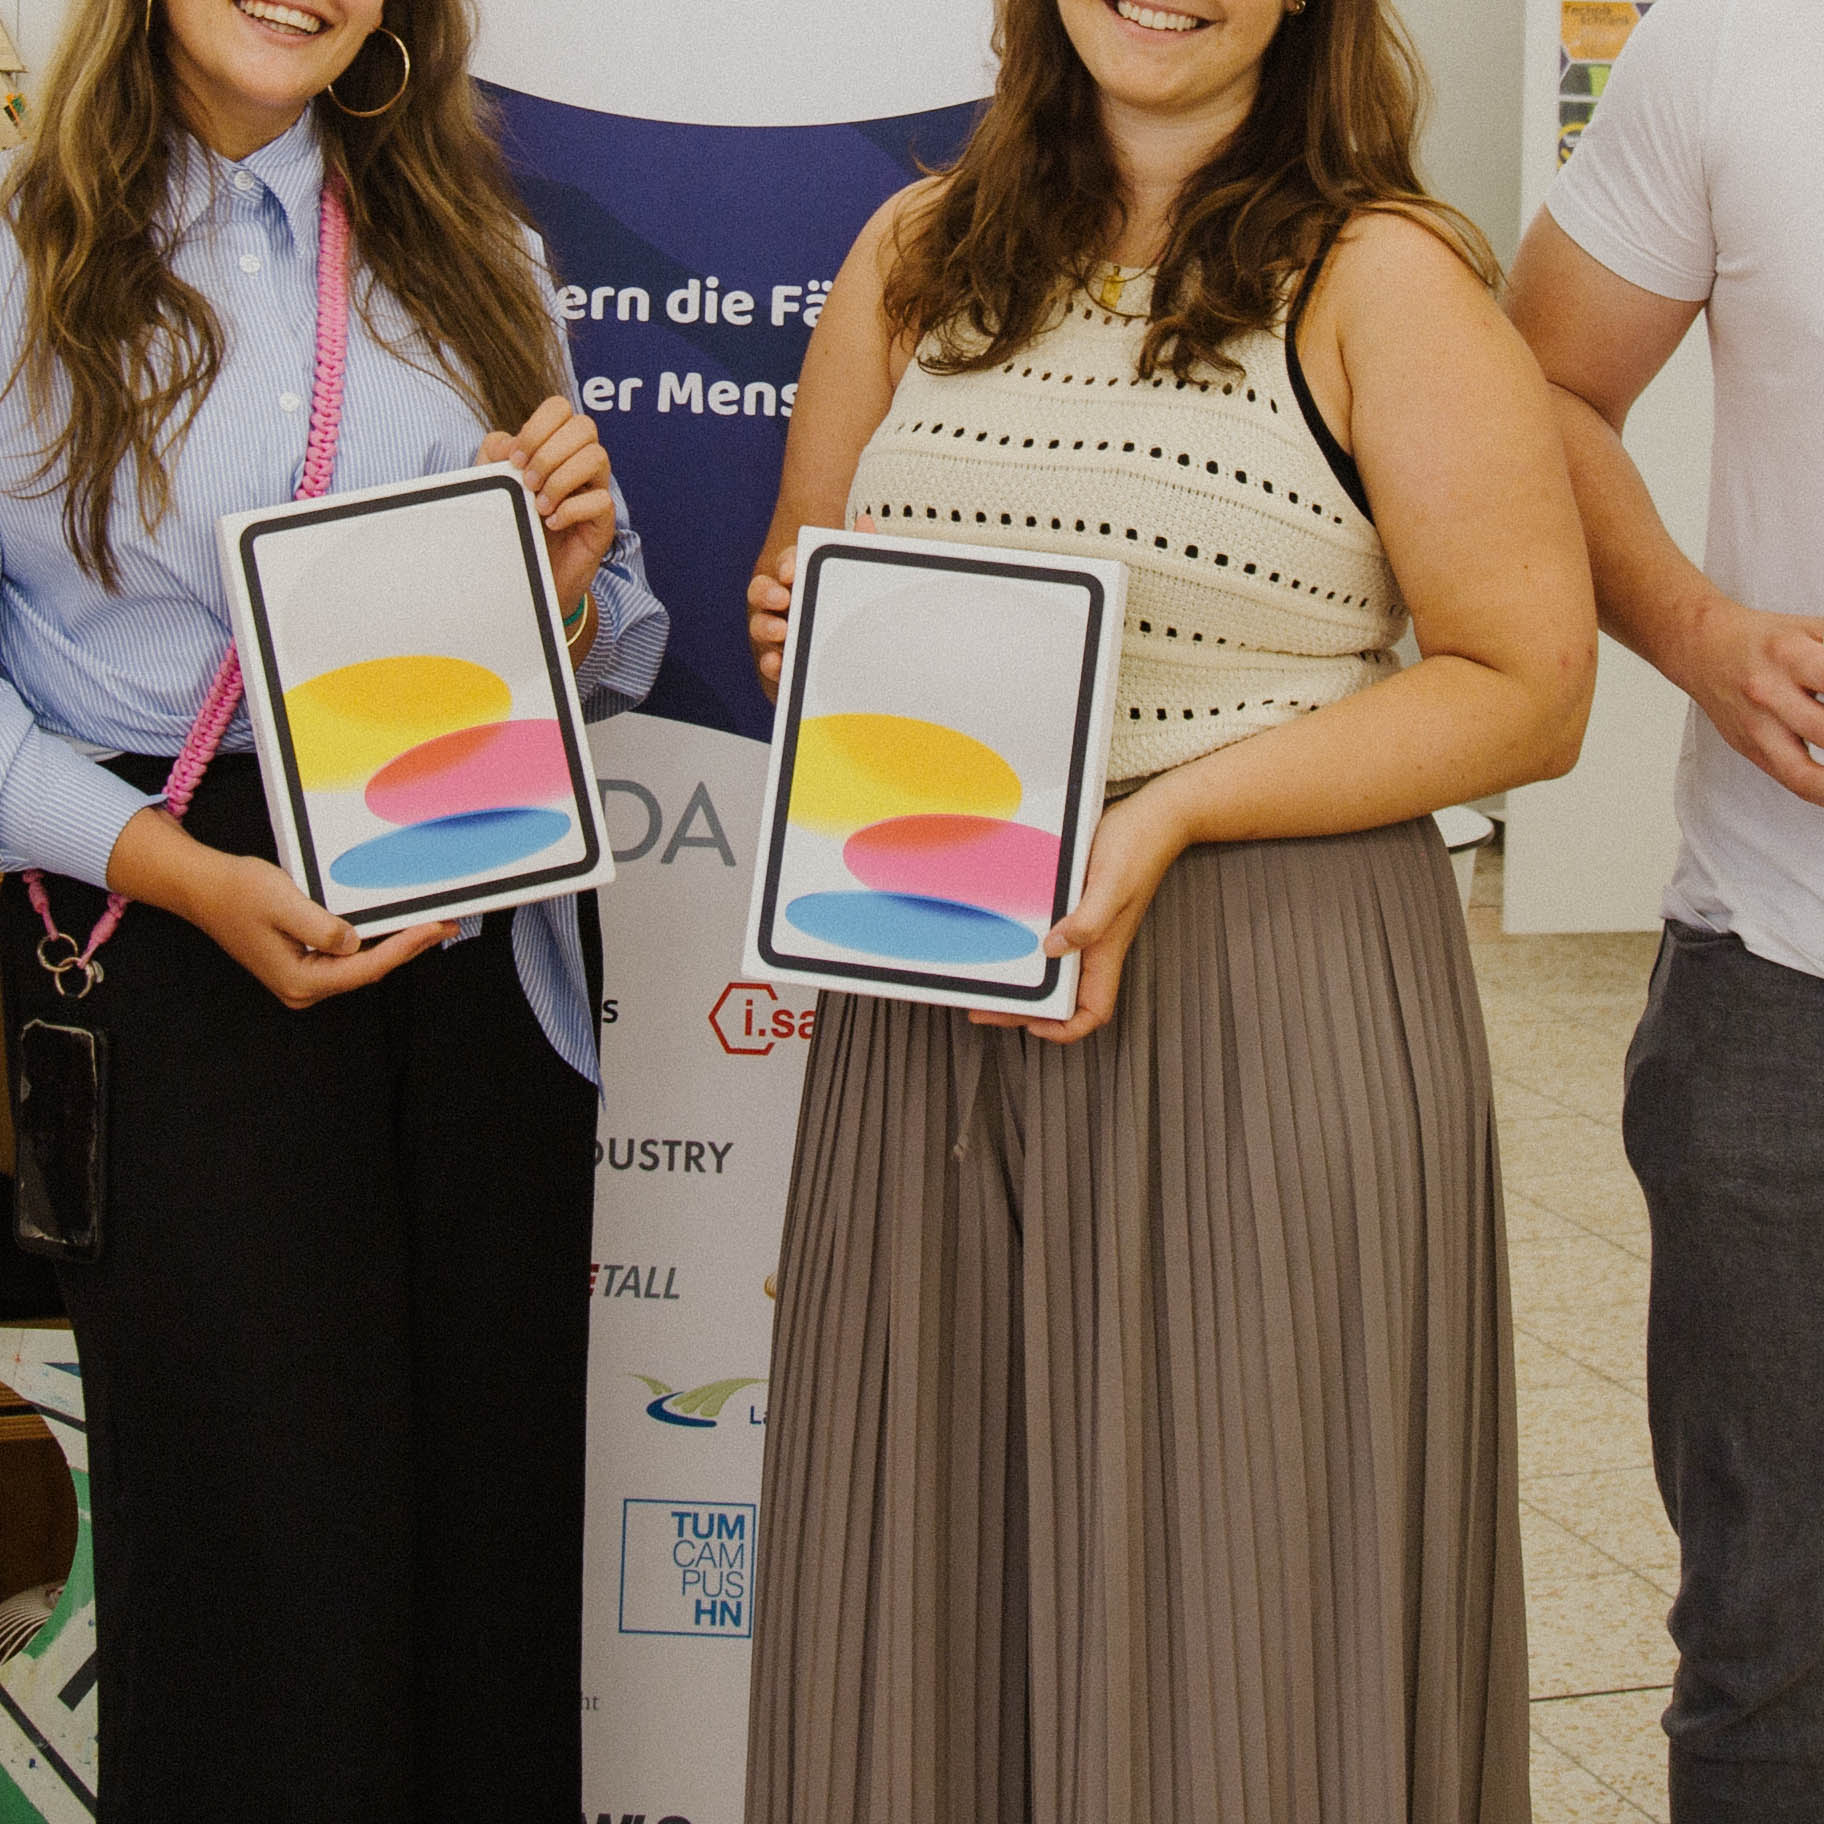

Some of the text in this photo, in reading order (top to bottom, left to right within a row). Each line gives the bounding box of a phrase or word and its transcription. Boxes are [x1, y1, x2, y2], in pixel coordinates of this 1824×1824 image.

[559, 275, 834, 328] ern die Fä
[582, 370, 799, 417] er Mens
[596, 778, 737, 867] DA
[743, 998, 816, 1041] i.sa
[671, 1511, 746, 1540] TUM
[673, 1539, 745, 1569] CAM
[682, 1569, 745, 1599] PUS
[694, 1599, 743, 1627] HN
